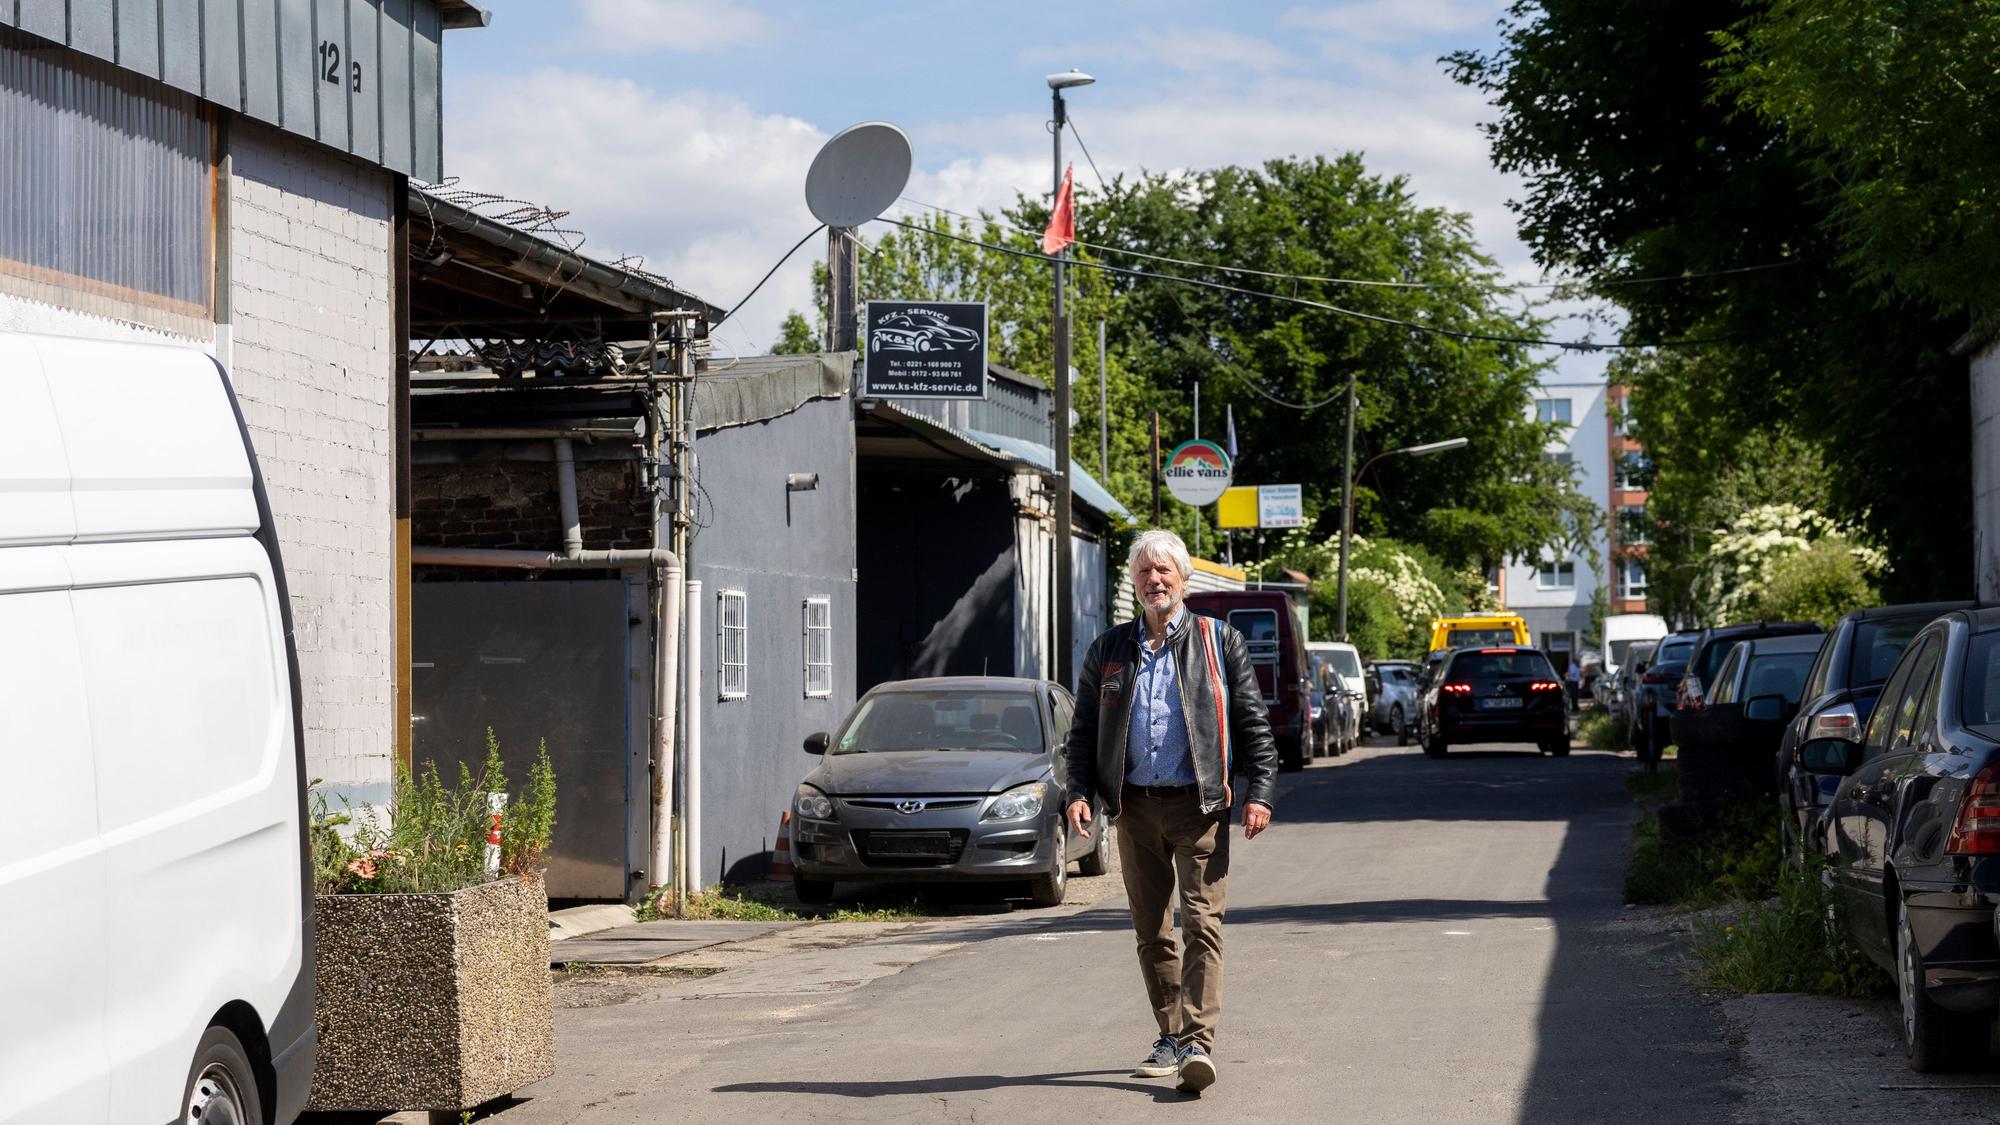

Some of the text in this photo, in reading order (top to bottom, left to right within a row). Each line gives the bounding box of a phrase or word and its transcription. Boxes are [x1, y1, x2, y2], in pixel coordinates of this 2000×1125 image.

[319, 40, 362, 93] 12 a
[878, 311, 898, 325] KFZ
[907, 308, 950, 322] SERVICE
[882, 333, 915, 346] K&S
[872, 382, 978, 392] www.ks-kfz-servic.de
[1166, 466, 1228, 478] ellie vans
